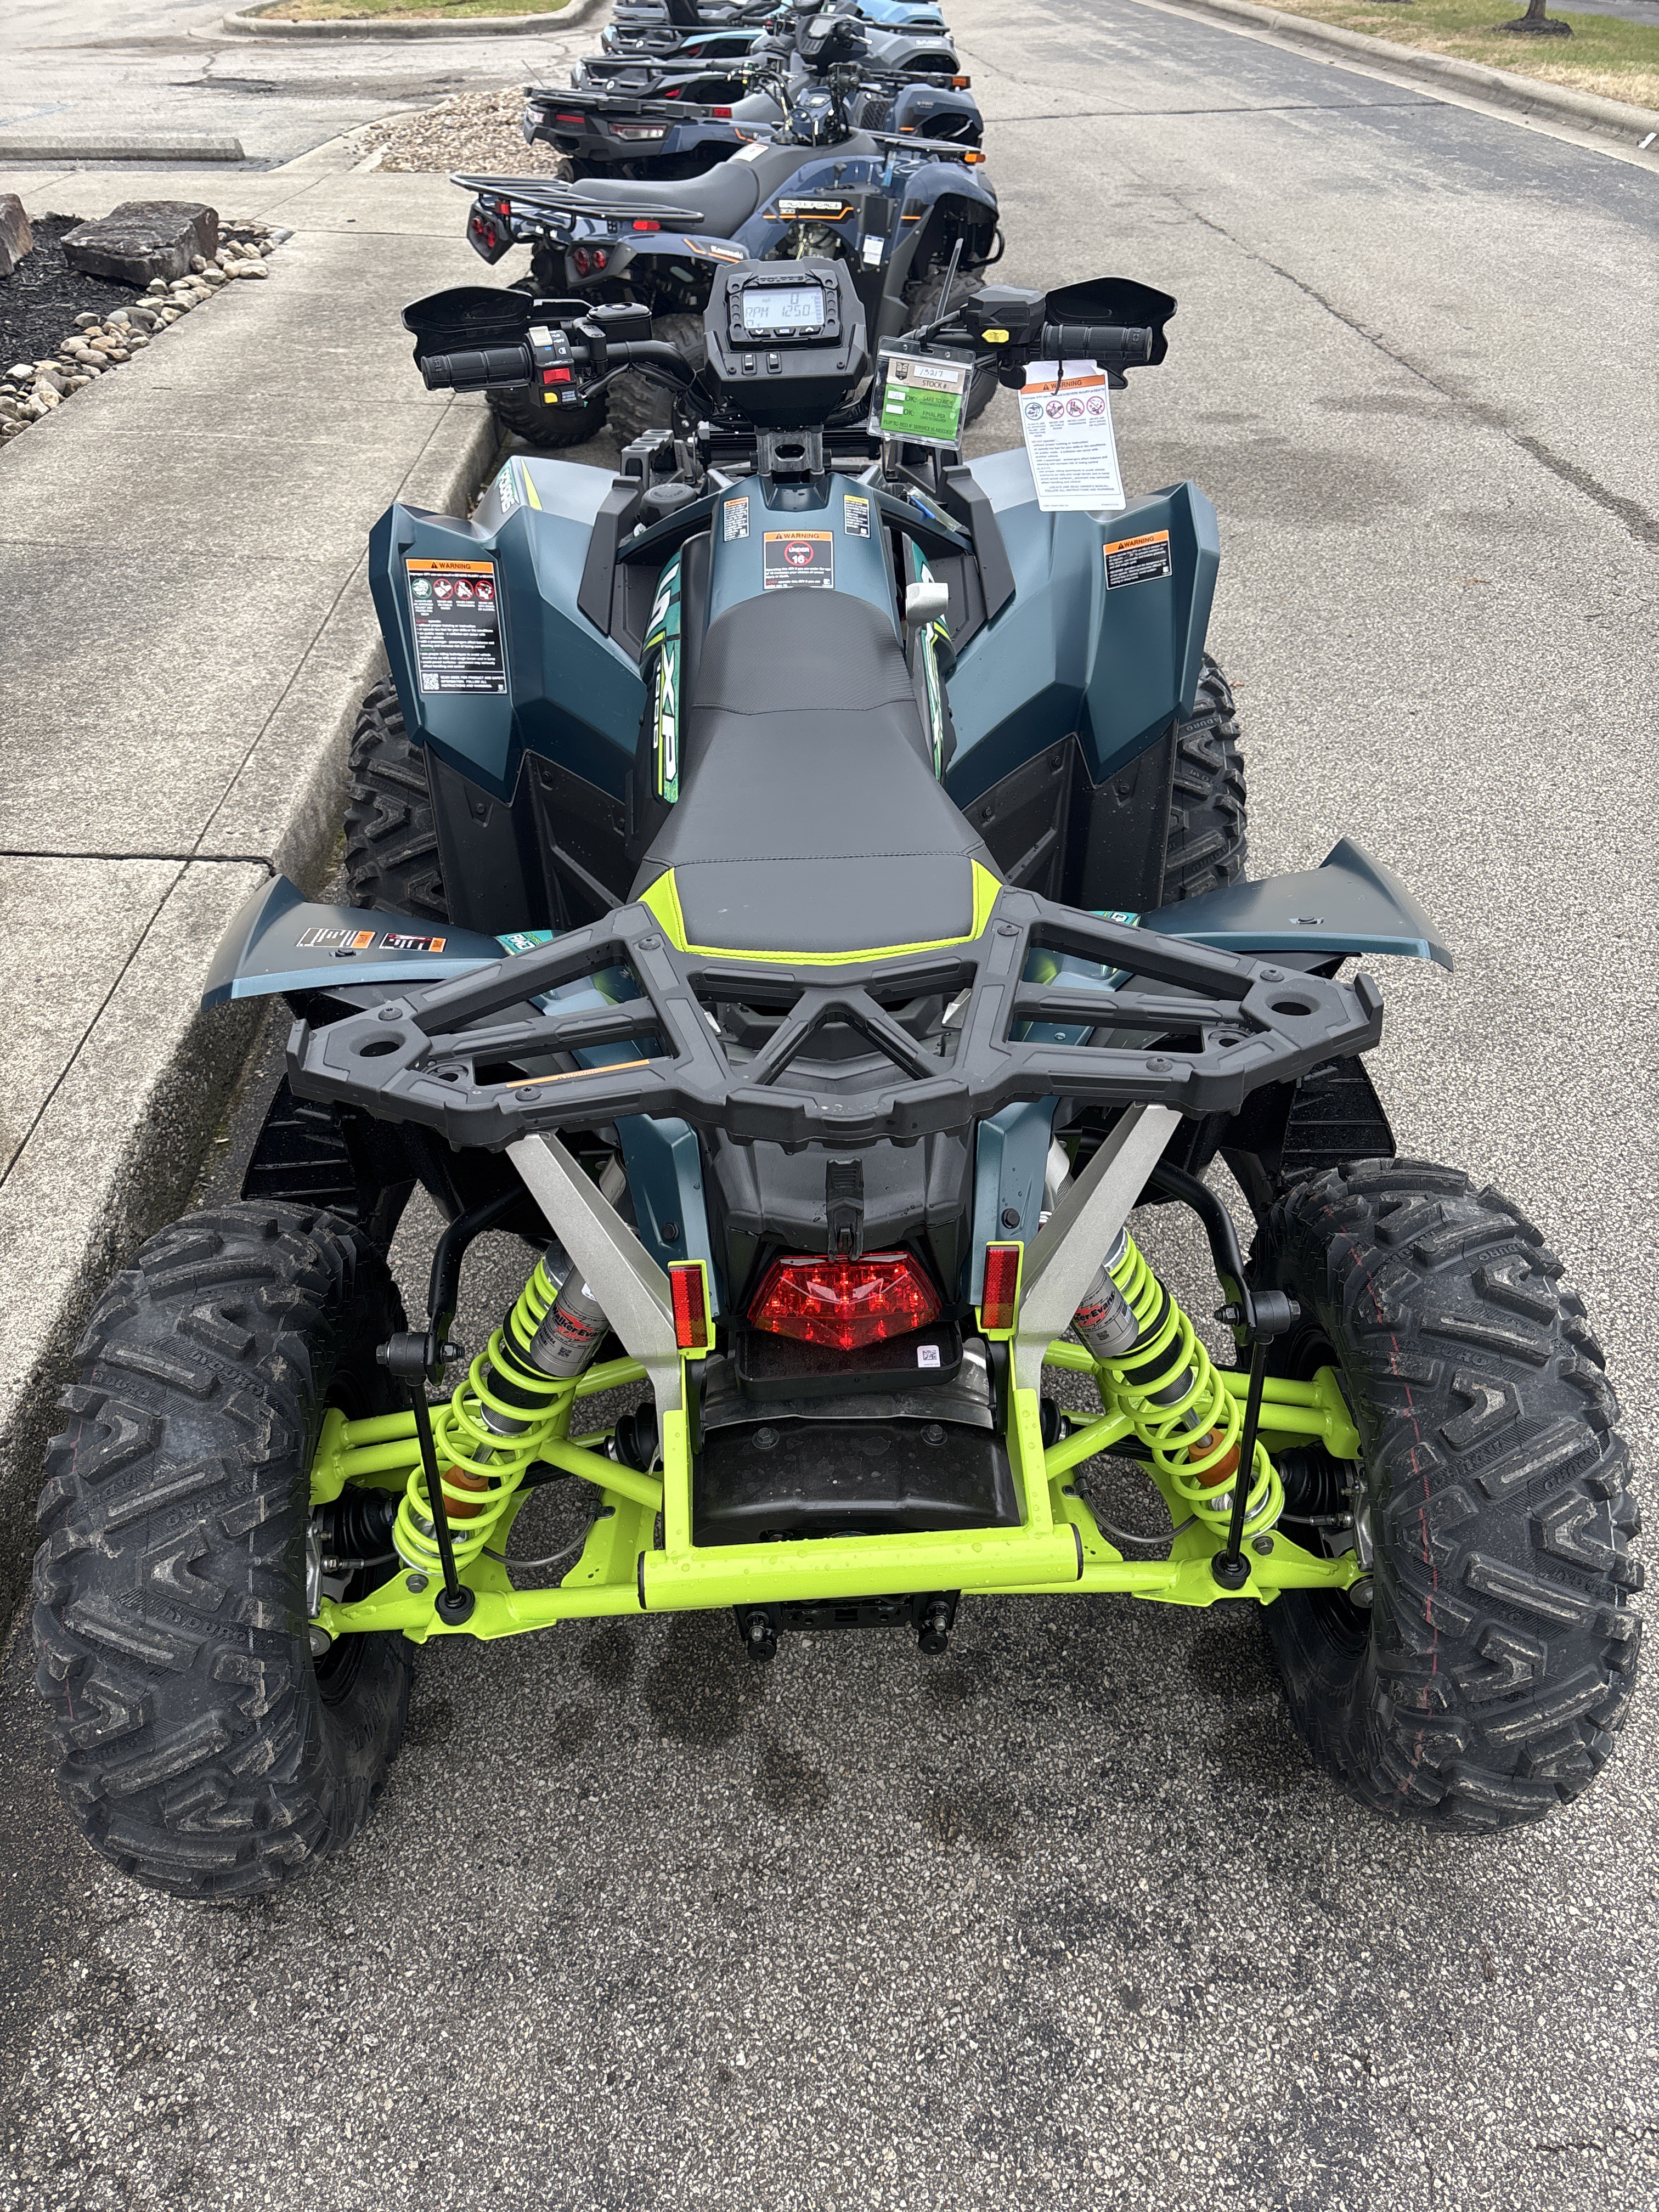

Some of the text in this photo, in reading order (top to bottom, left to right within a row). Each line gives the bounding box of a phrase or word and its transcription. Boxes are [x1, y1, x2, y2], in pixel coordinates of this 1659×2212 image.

[790, 293, 799, 304] 0
[746, 304, 810, 318] RPM 1250
[922, 380, 942, 388] STOCK
[935, 427, 953, 435] NEEDED
[499, 467, 515, 513] POLARIS
[1124, 536, 1154, 548] WARNING
[792, 555, 805, 564] 16
[661, 644, 677, 781] XP
[506, 934, 535, 950] AWD
[1479, 1245, 1519, 1261] DURO
[1091, 1291, 1115, 1318] Evans
[553, 1304, 577, 1333] Walker
[187, 1616, 247, 1643] DURO
